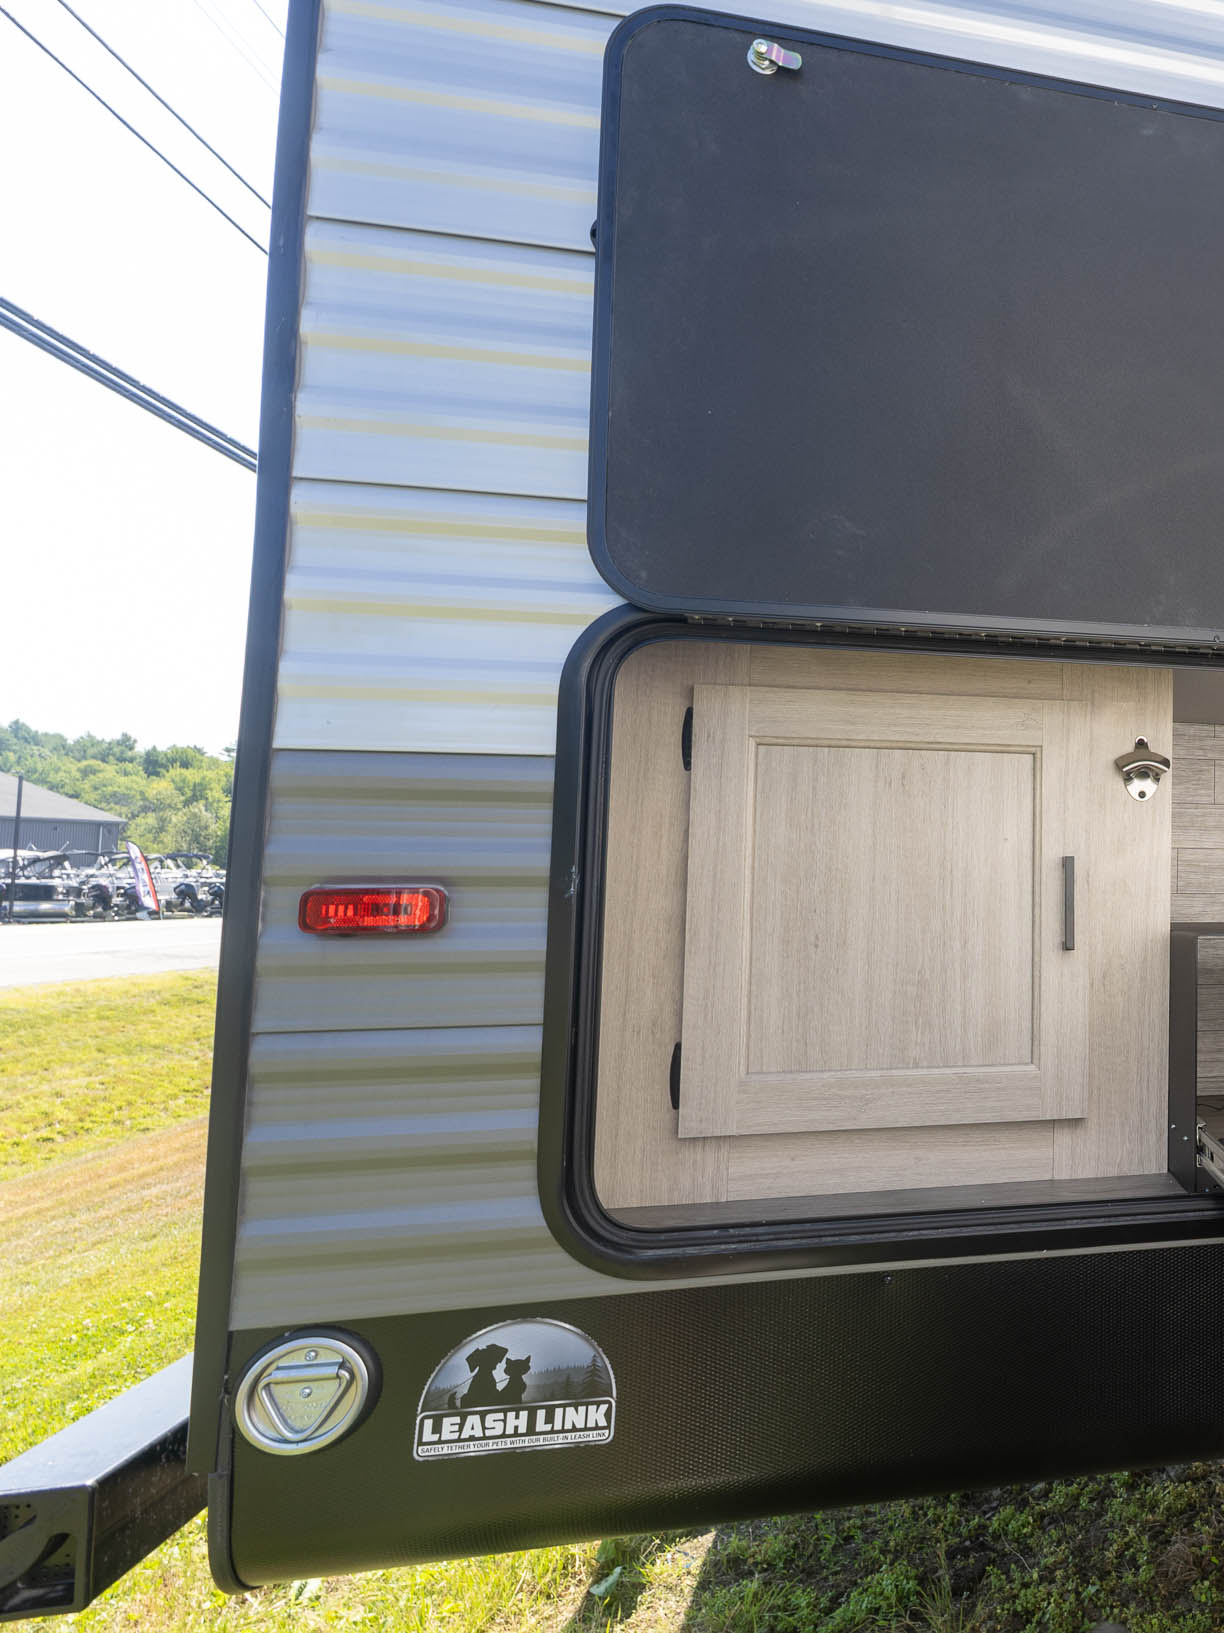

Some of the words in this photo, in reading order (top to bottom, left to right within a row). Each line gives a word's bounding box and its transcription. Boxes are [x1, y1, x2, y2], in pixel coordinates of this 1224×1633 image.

[421, 1410, 528, 1443] LEASH
[535, 1404, 609, 1432] LINK
[420, 1445, 447, 1455] SAFELY
[447, 1443, 472, 1452] TETHER
[472, 1441, 490, 1449] YOUR
[509, 1438, 526, 1446] WITH
[527, 1436, 541, 1444] OUR
[542, 1434, 569, 1443] BUILT-IN
[570, 1432, 591, 1441] LEASH
[592, 1431, 607, 1439] LINK
